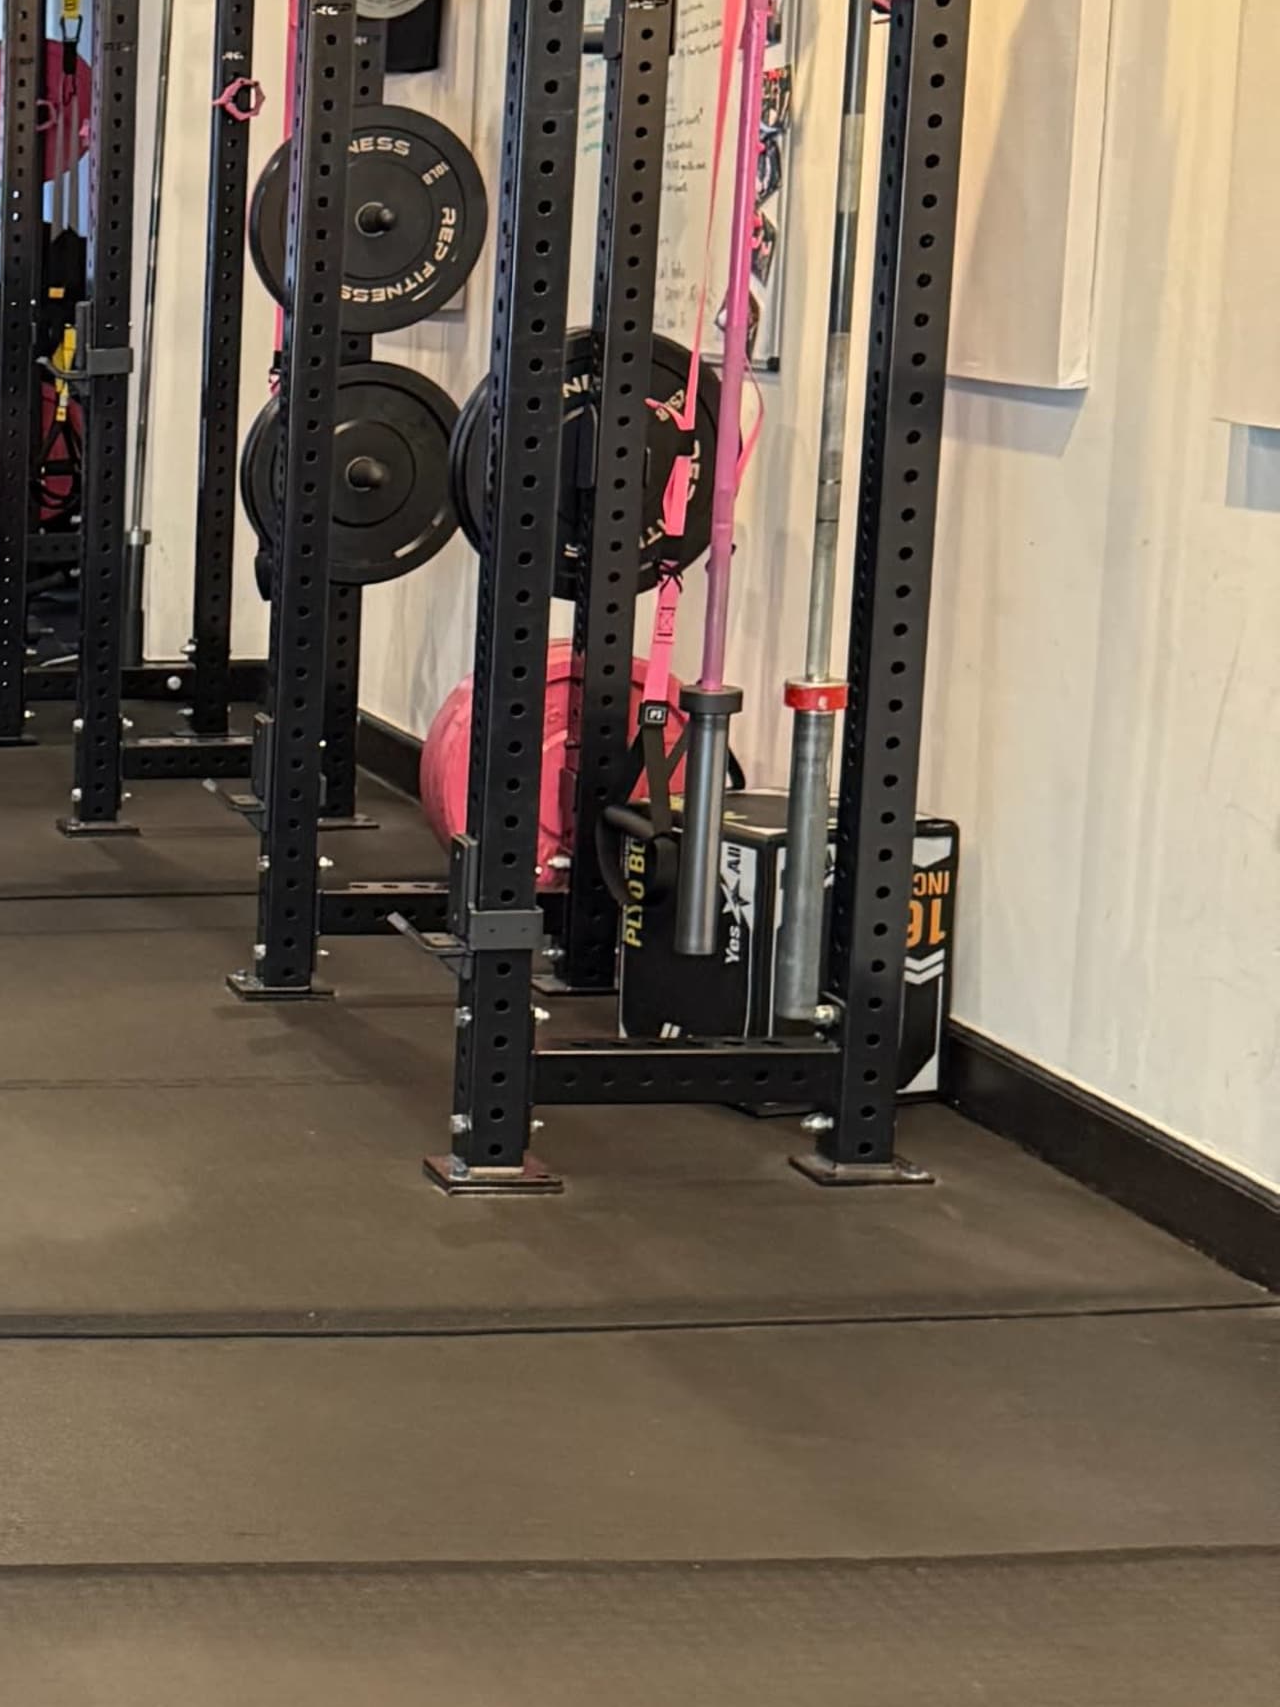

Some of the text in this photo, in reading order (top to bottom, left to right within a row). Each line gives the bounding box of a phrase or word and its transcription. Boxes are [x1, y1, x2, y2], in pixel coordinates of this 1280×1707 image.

[348, 137, 410, 157] NESS
[341, 207, 456, 303] REP FITNESS
[913, 871, 949, 896] INC
